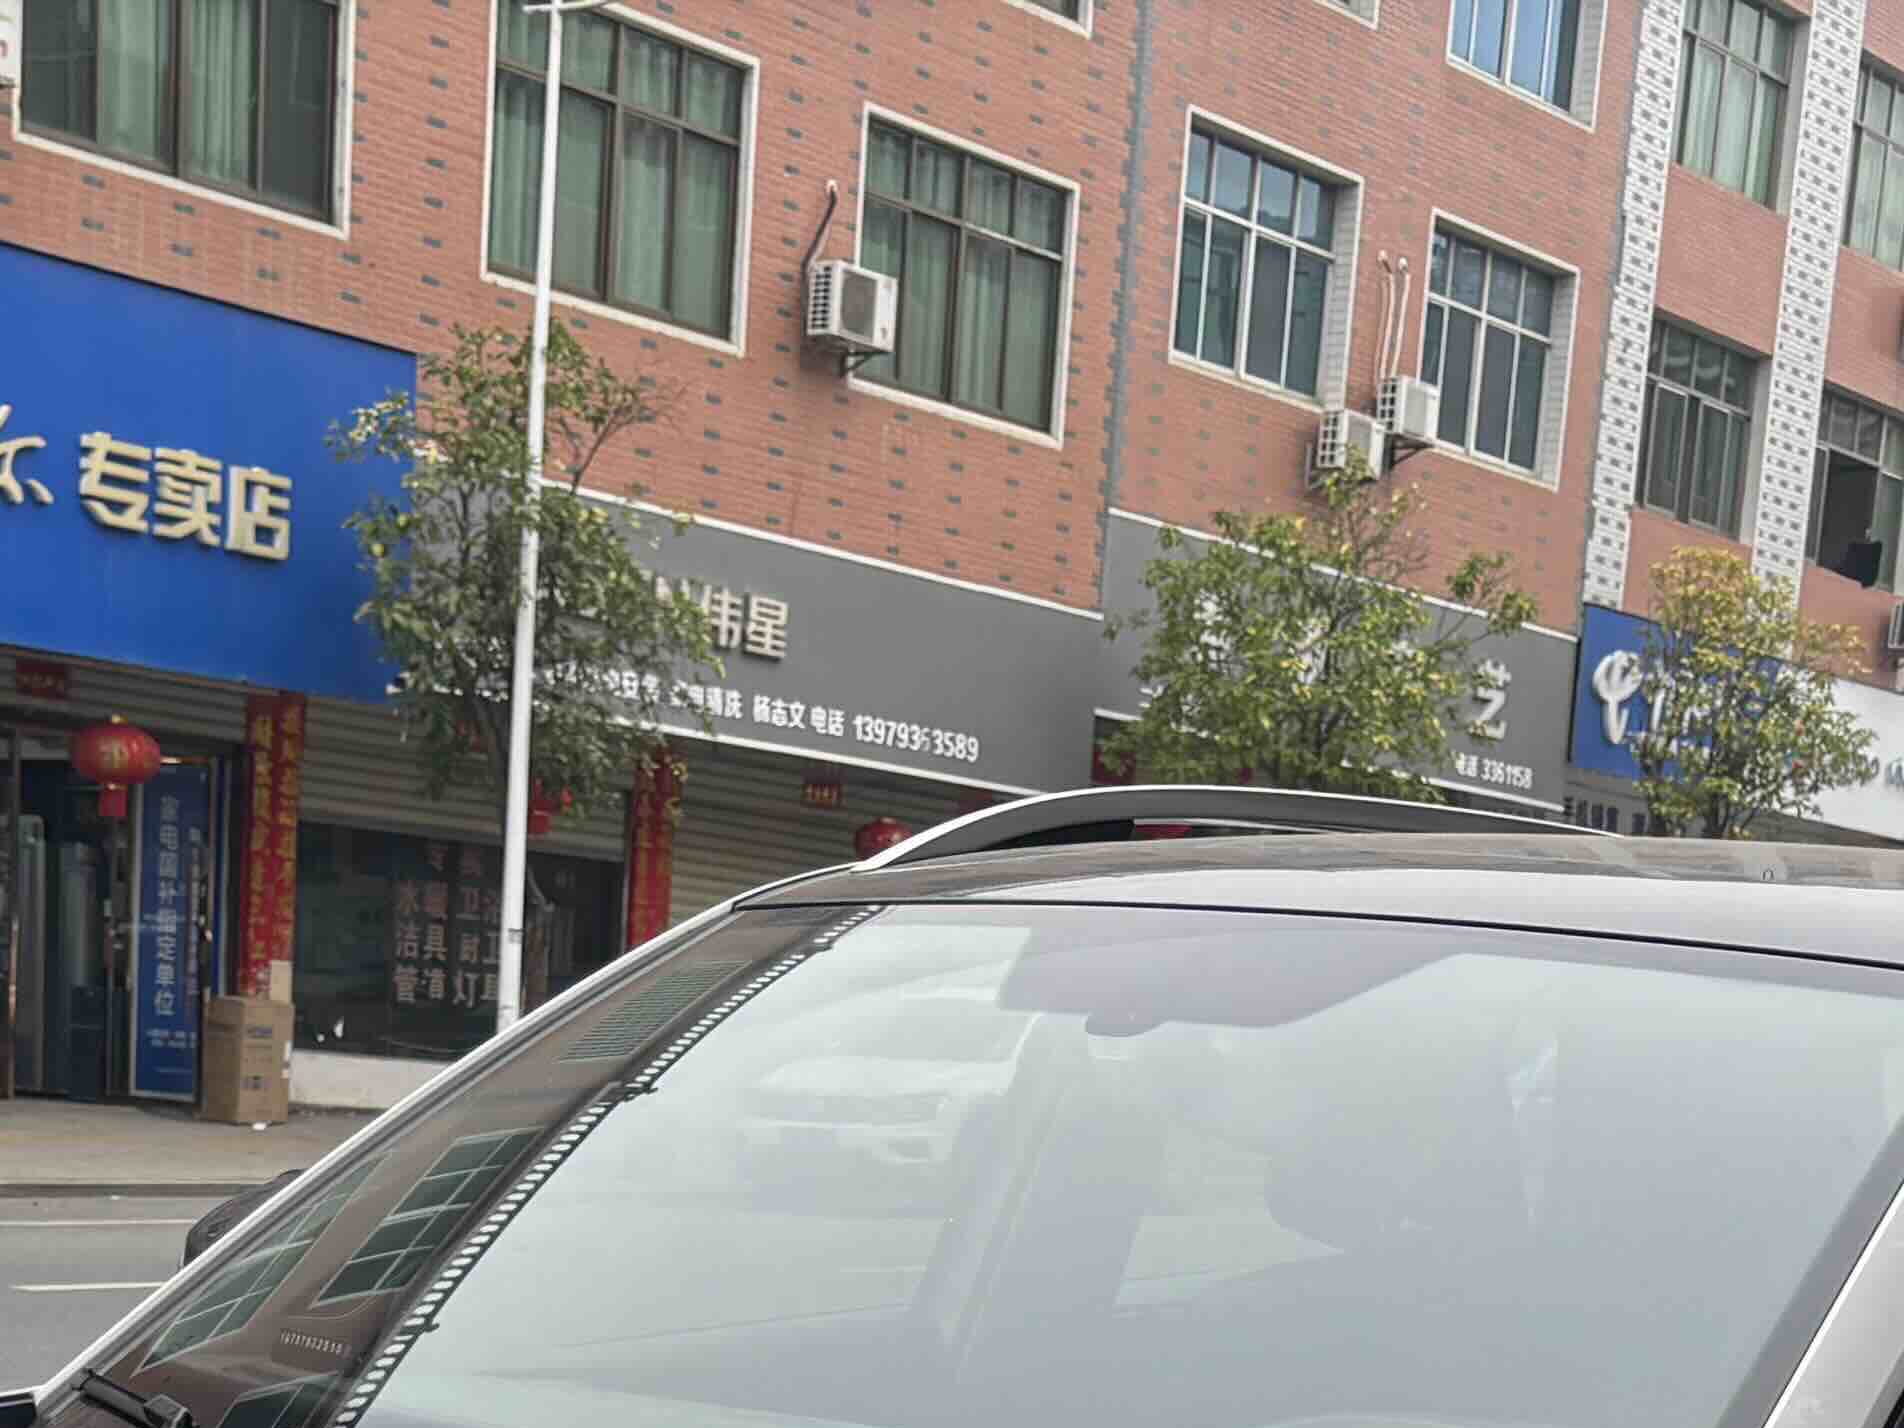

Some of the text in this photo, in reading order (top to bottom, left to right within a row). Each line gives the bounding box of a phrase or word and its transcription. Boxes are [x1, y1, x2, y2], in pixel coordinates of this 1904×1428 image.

[77, 431, 293, 561] 专卖店
[810, 705, 845, 737] 电话
